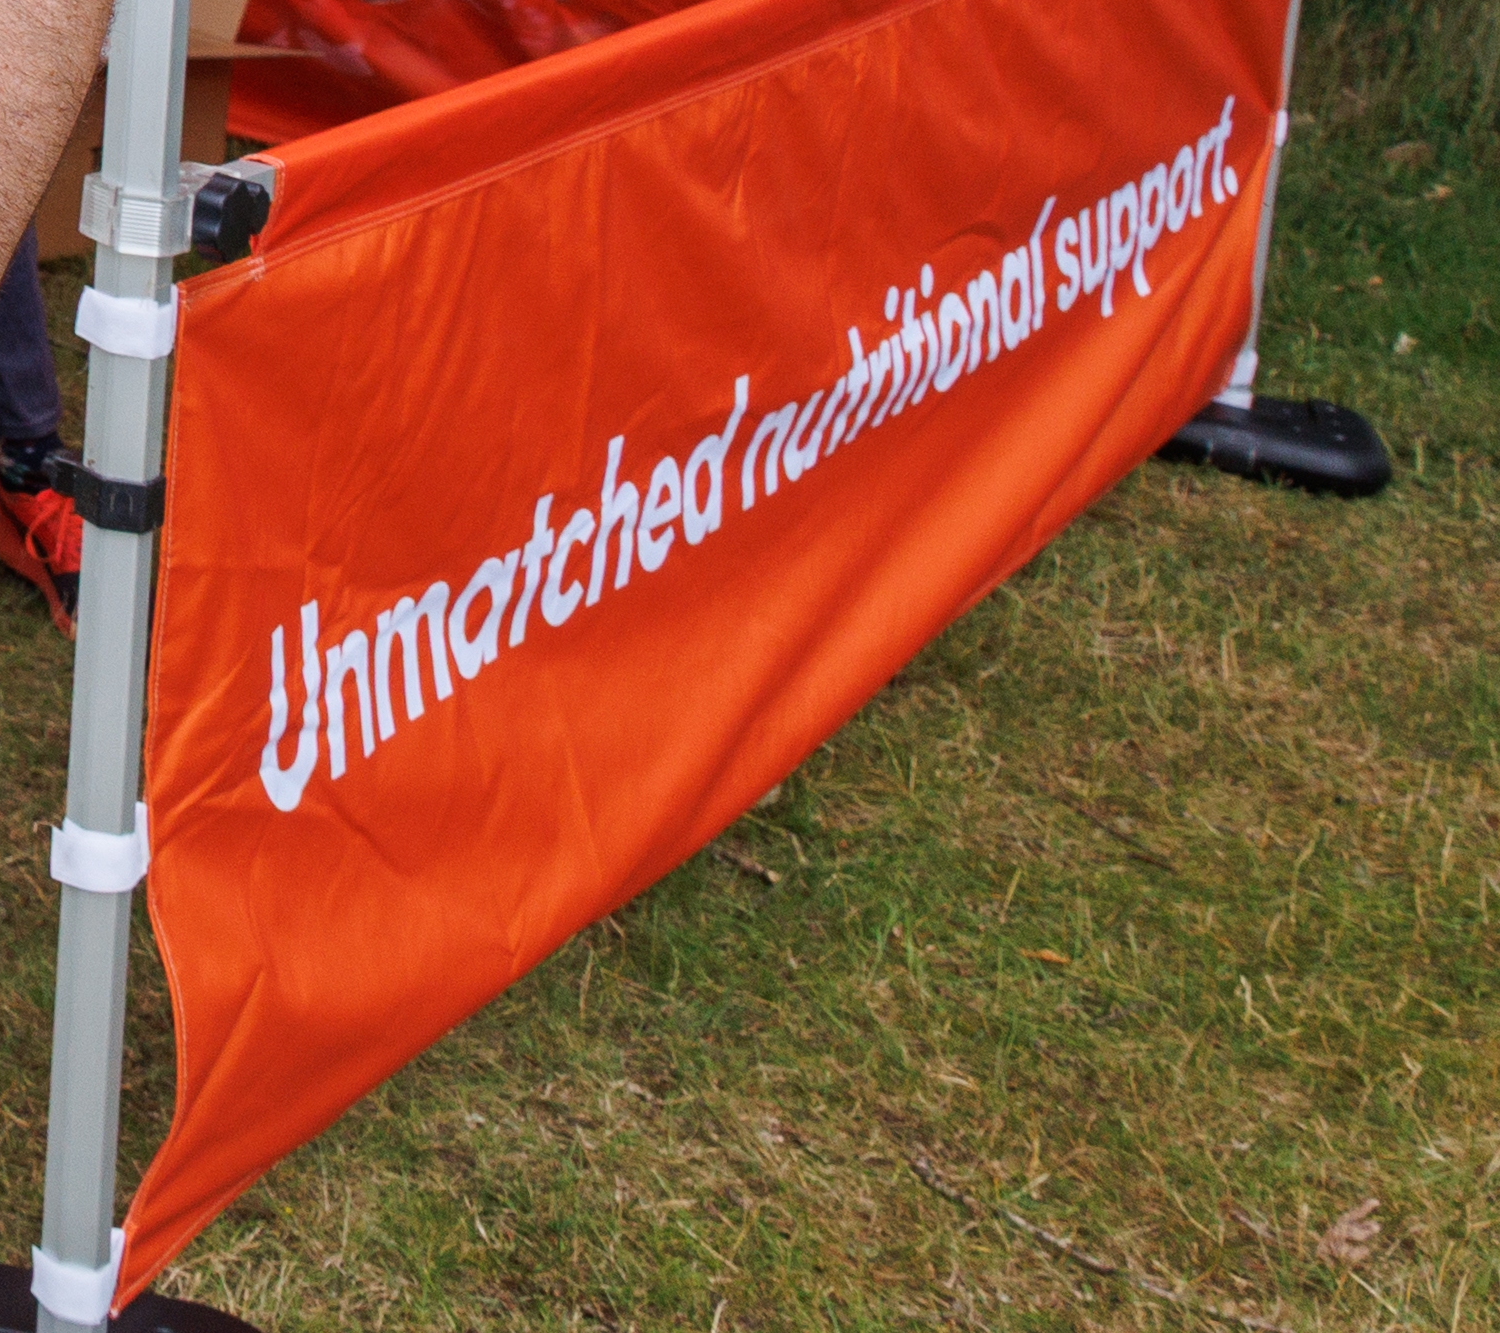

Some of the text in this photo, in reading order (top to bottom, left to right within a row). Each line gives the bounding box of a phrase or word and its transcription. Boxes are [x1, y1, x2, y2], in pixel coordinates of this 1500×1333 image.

[258, 94, 1240, 813] Unmatched nutritional support.
